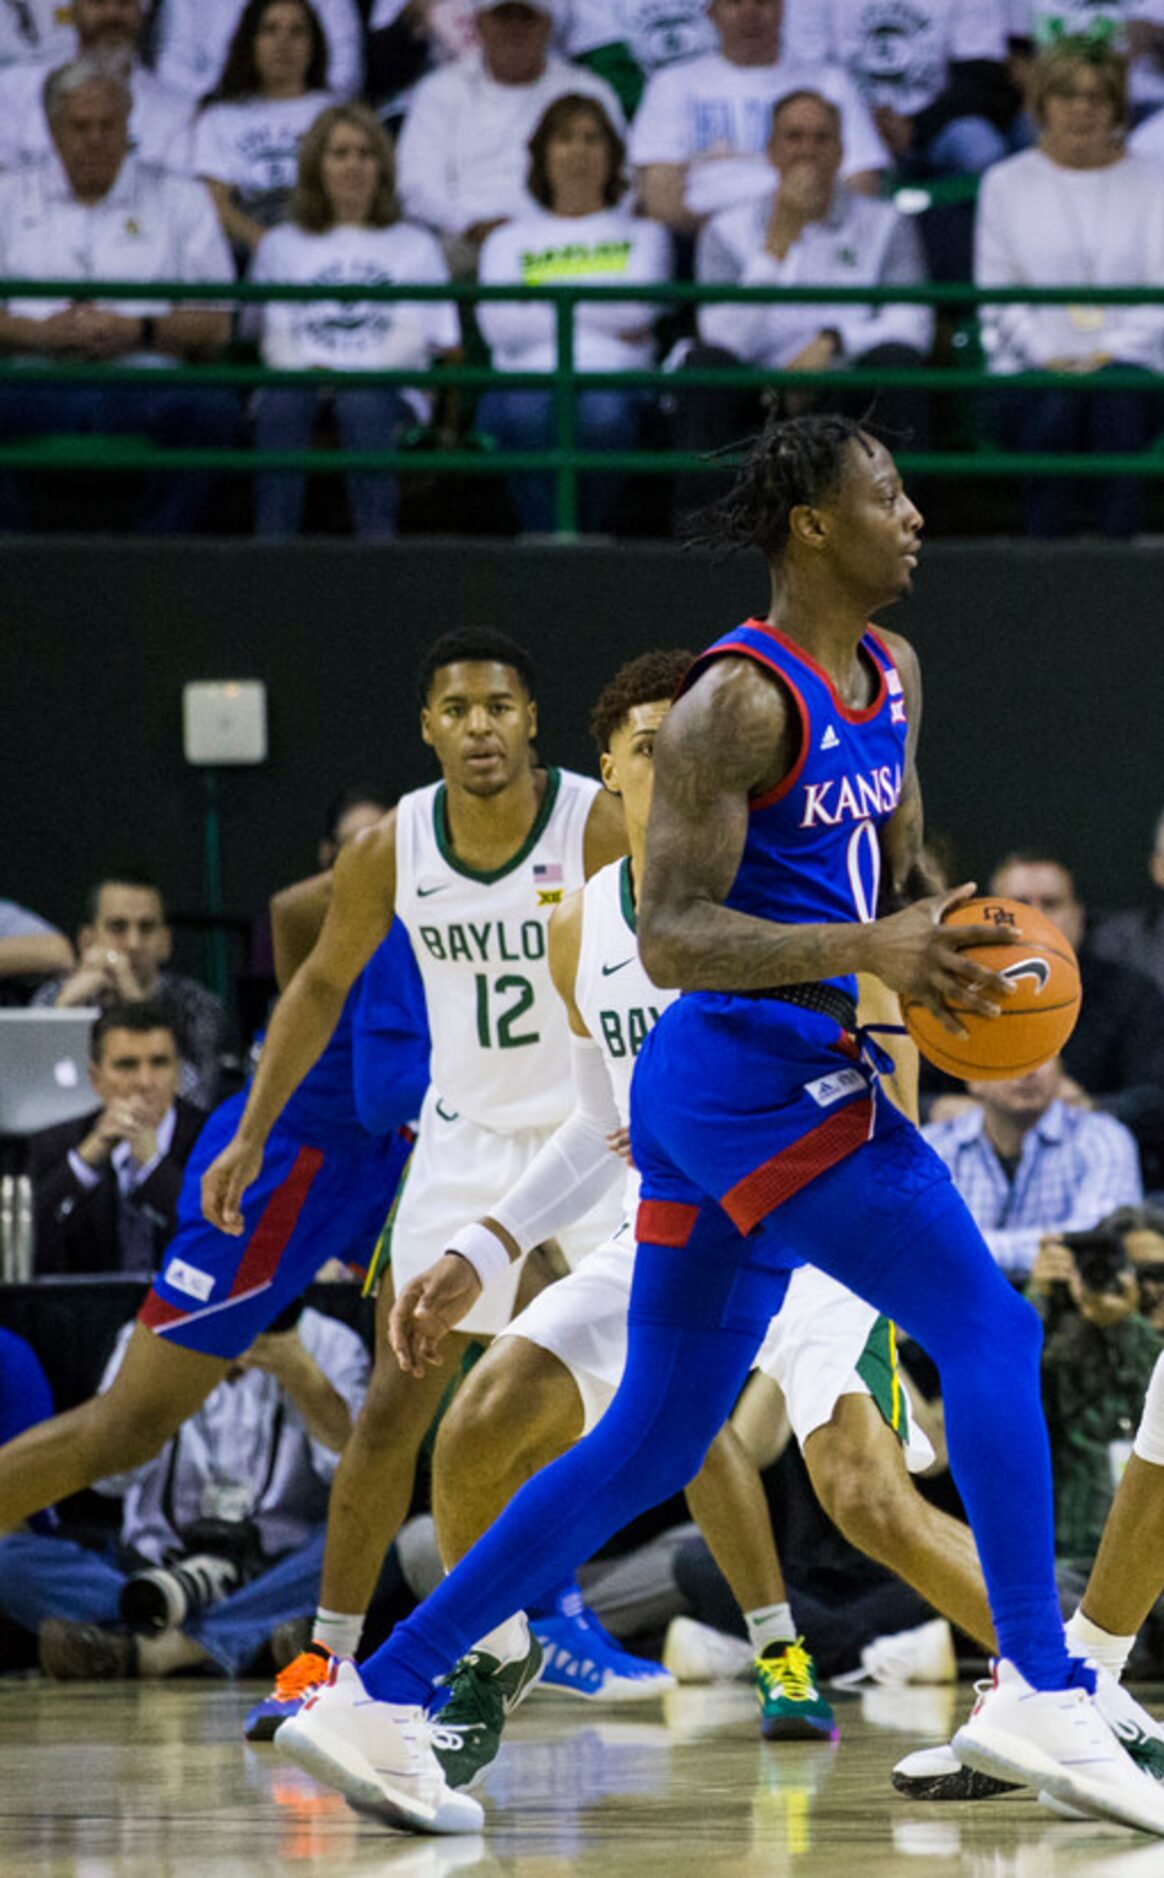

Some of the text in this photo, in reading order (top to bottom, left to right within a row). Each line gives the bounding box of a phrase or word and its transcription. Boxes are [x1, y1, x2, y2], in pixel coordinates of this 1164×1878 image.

[847, 819, 881, 925] 0
[419, 920, 545, 962] BAYLO
[475, 973, 540, 1049] 12
